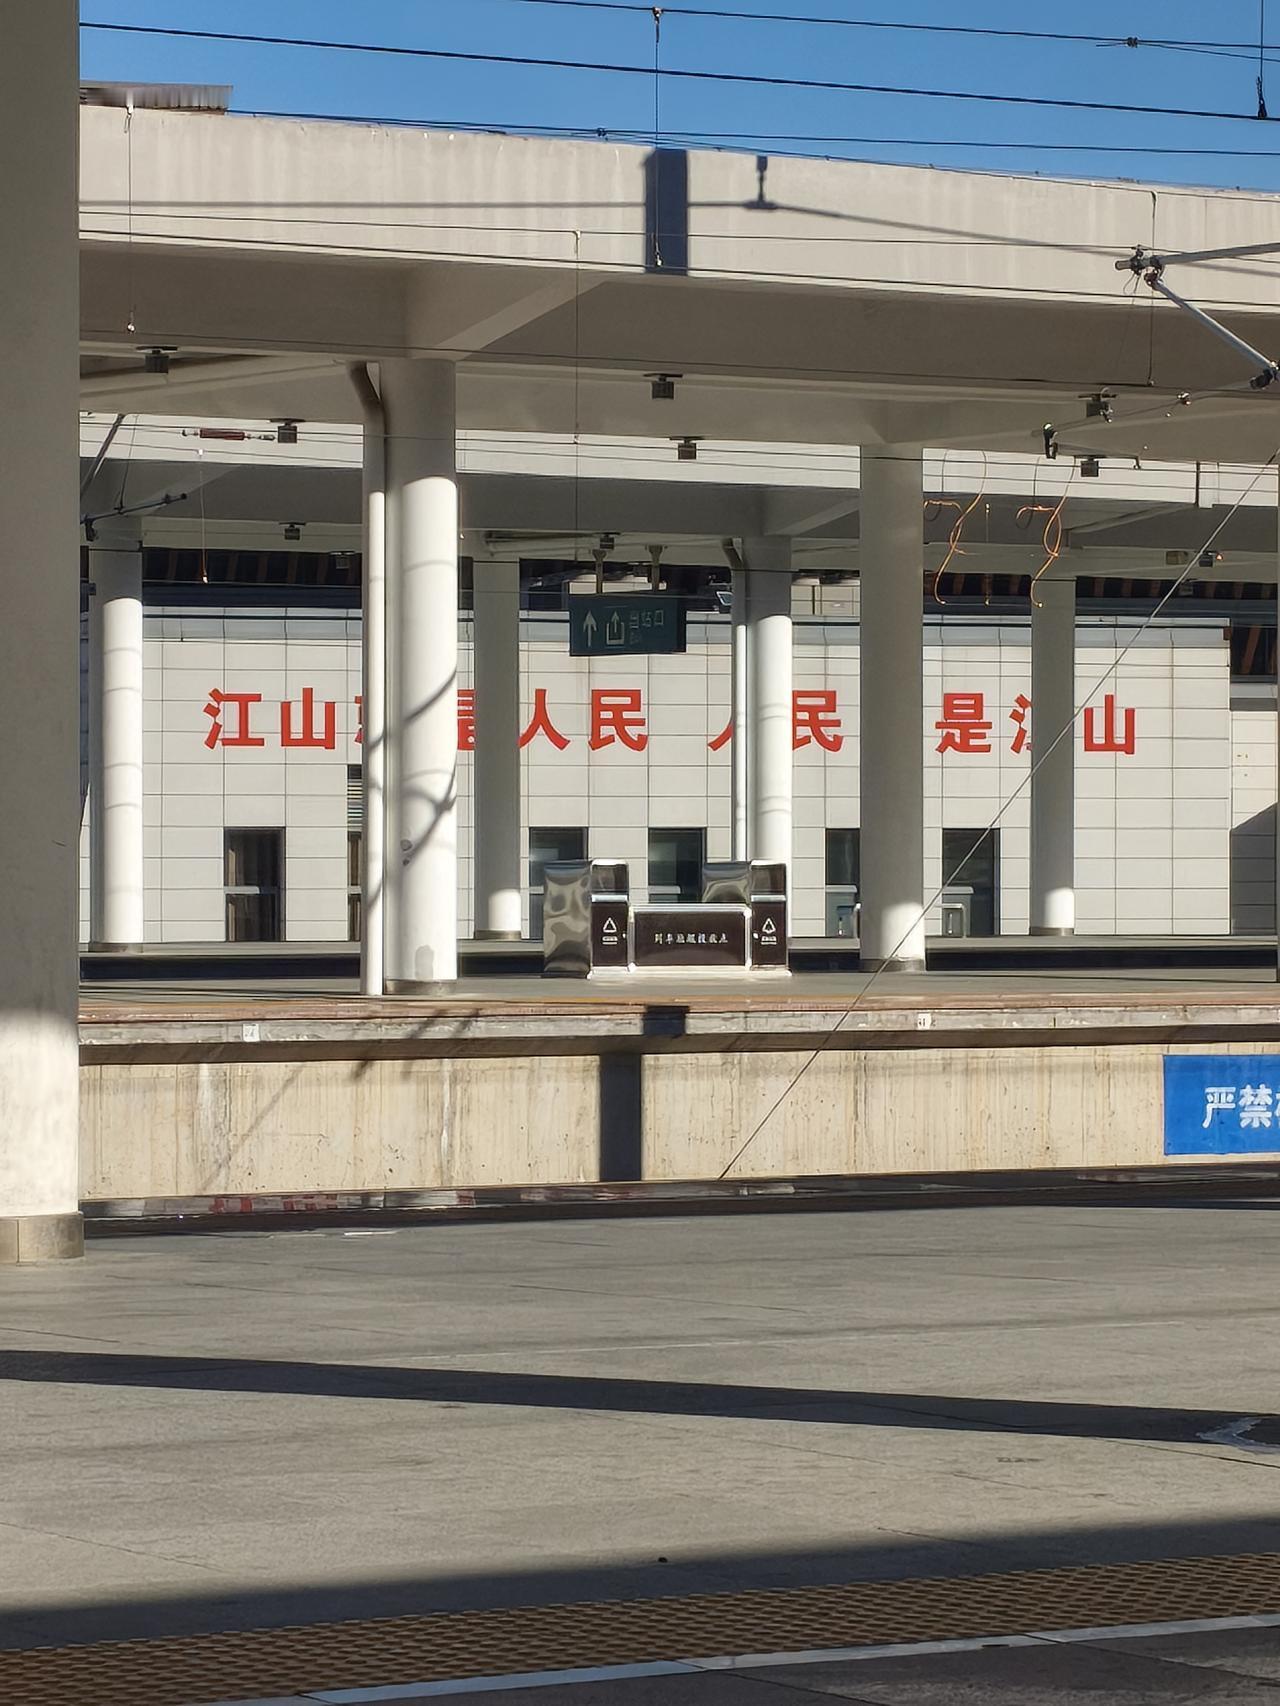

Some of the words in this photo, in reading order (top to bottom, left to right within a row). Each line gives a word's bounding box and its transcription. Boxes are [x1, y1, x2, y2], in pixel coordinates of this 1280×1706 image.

[203, 688, 647, 750] 江山人民
[1201, 1083, 1280, 1129] 严禁
